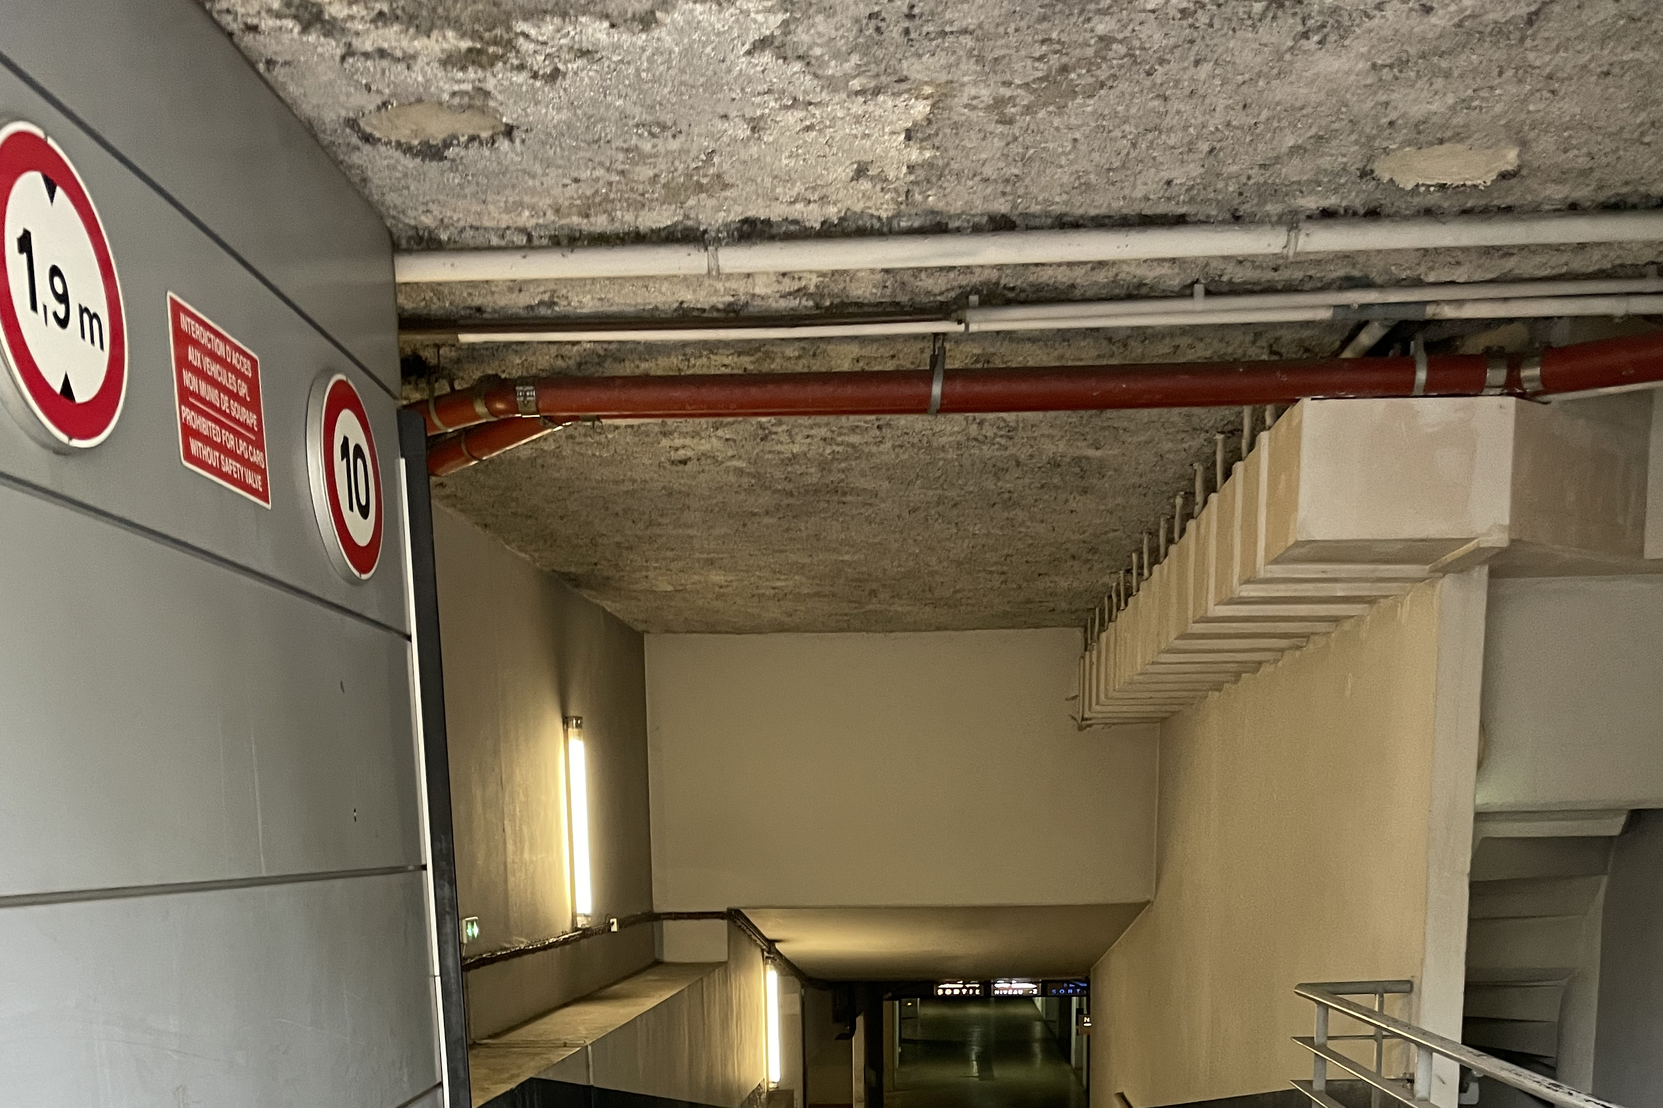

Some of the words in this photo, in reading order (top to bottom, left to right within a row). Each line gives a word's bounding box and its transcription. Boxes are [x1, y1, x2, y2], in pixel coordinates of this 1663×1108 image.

[16, 227, 70, 330] 1,9
[78, 302, 105, 352] m
[180, 311, 226, 359] INTERDICTION
[183, 368, 199, 394] NON
[199, 378, 220, 408] MUNIS
[220, 392, 230, 414] DE
[229, 398, 258, 431] SOUPAPE
[188, 345, 203, 370] AUX
[201, 354, 238, 393] VEHICULES
[237, 379, 250, 401] GPL
[180, 404, 222, 443] PROHIBITED
[221, 428, 236, 453] FOR
[235, 437, 249, 459] LPG
[248, 444, 265, 469] CARS
[189, 436, 220, 468] WITHOUT
[220, 454, 244, 482] SAFETY
[243, 466, 263, 492] VALVE
[340, 435, 370, 521] 10
